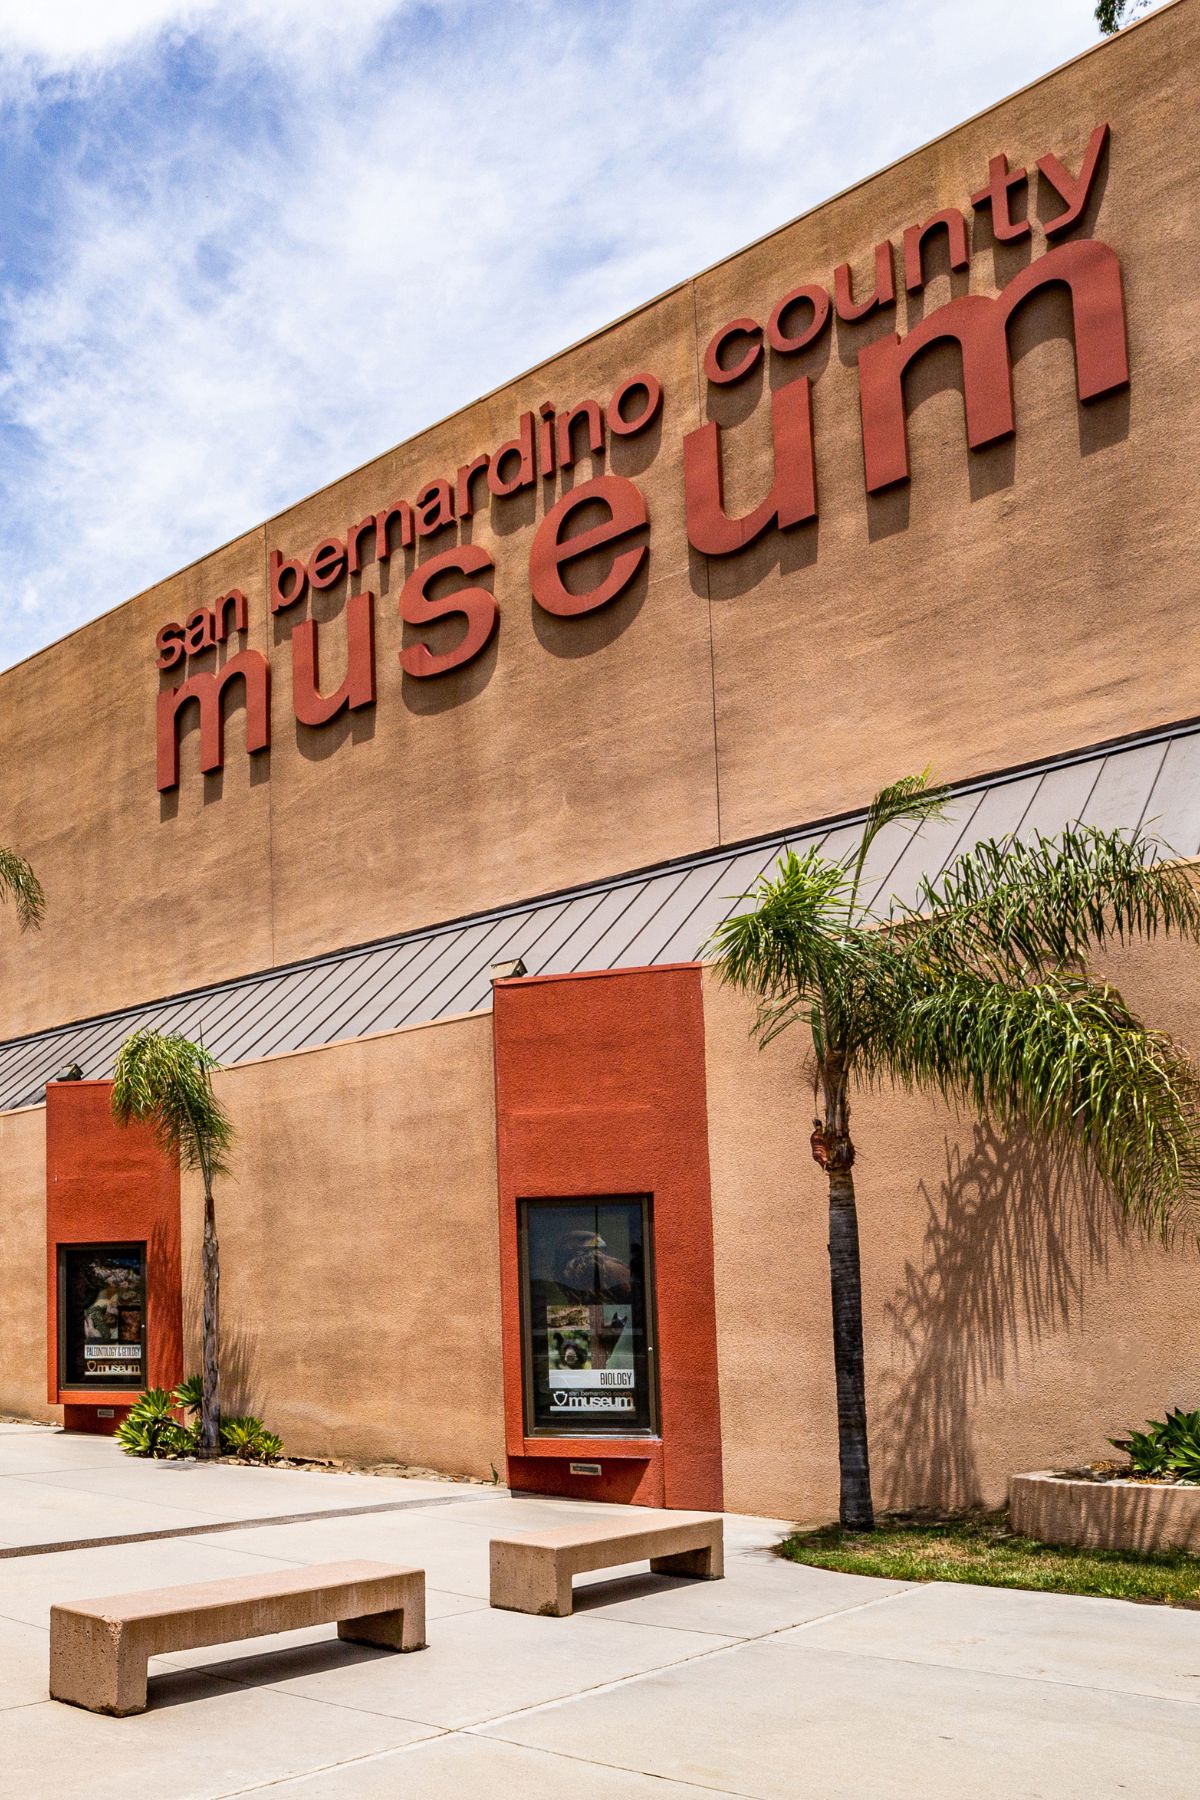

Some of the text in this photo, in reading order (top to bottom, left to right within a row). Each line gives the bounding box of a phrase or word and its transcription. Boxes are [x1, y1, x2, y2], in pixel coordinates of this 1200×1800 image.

[156, 123, 1110, 669] san bernardino county
[157, 239, 1130, 792] museum
[87, 1346, 116, 1356] PALEONTOLOGY
[122, 1346, 141, 1356] GEOLOGY
[97, 1364, 140, 1372] museum
[600, 1372, 632, 1386] BIOLOGY
[569, 1396, 634, 1407] museum
